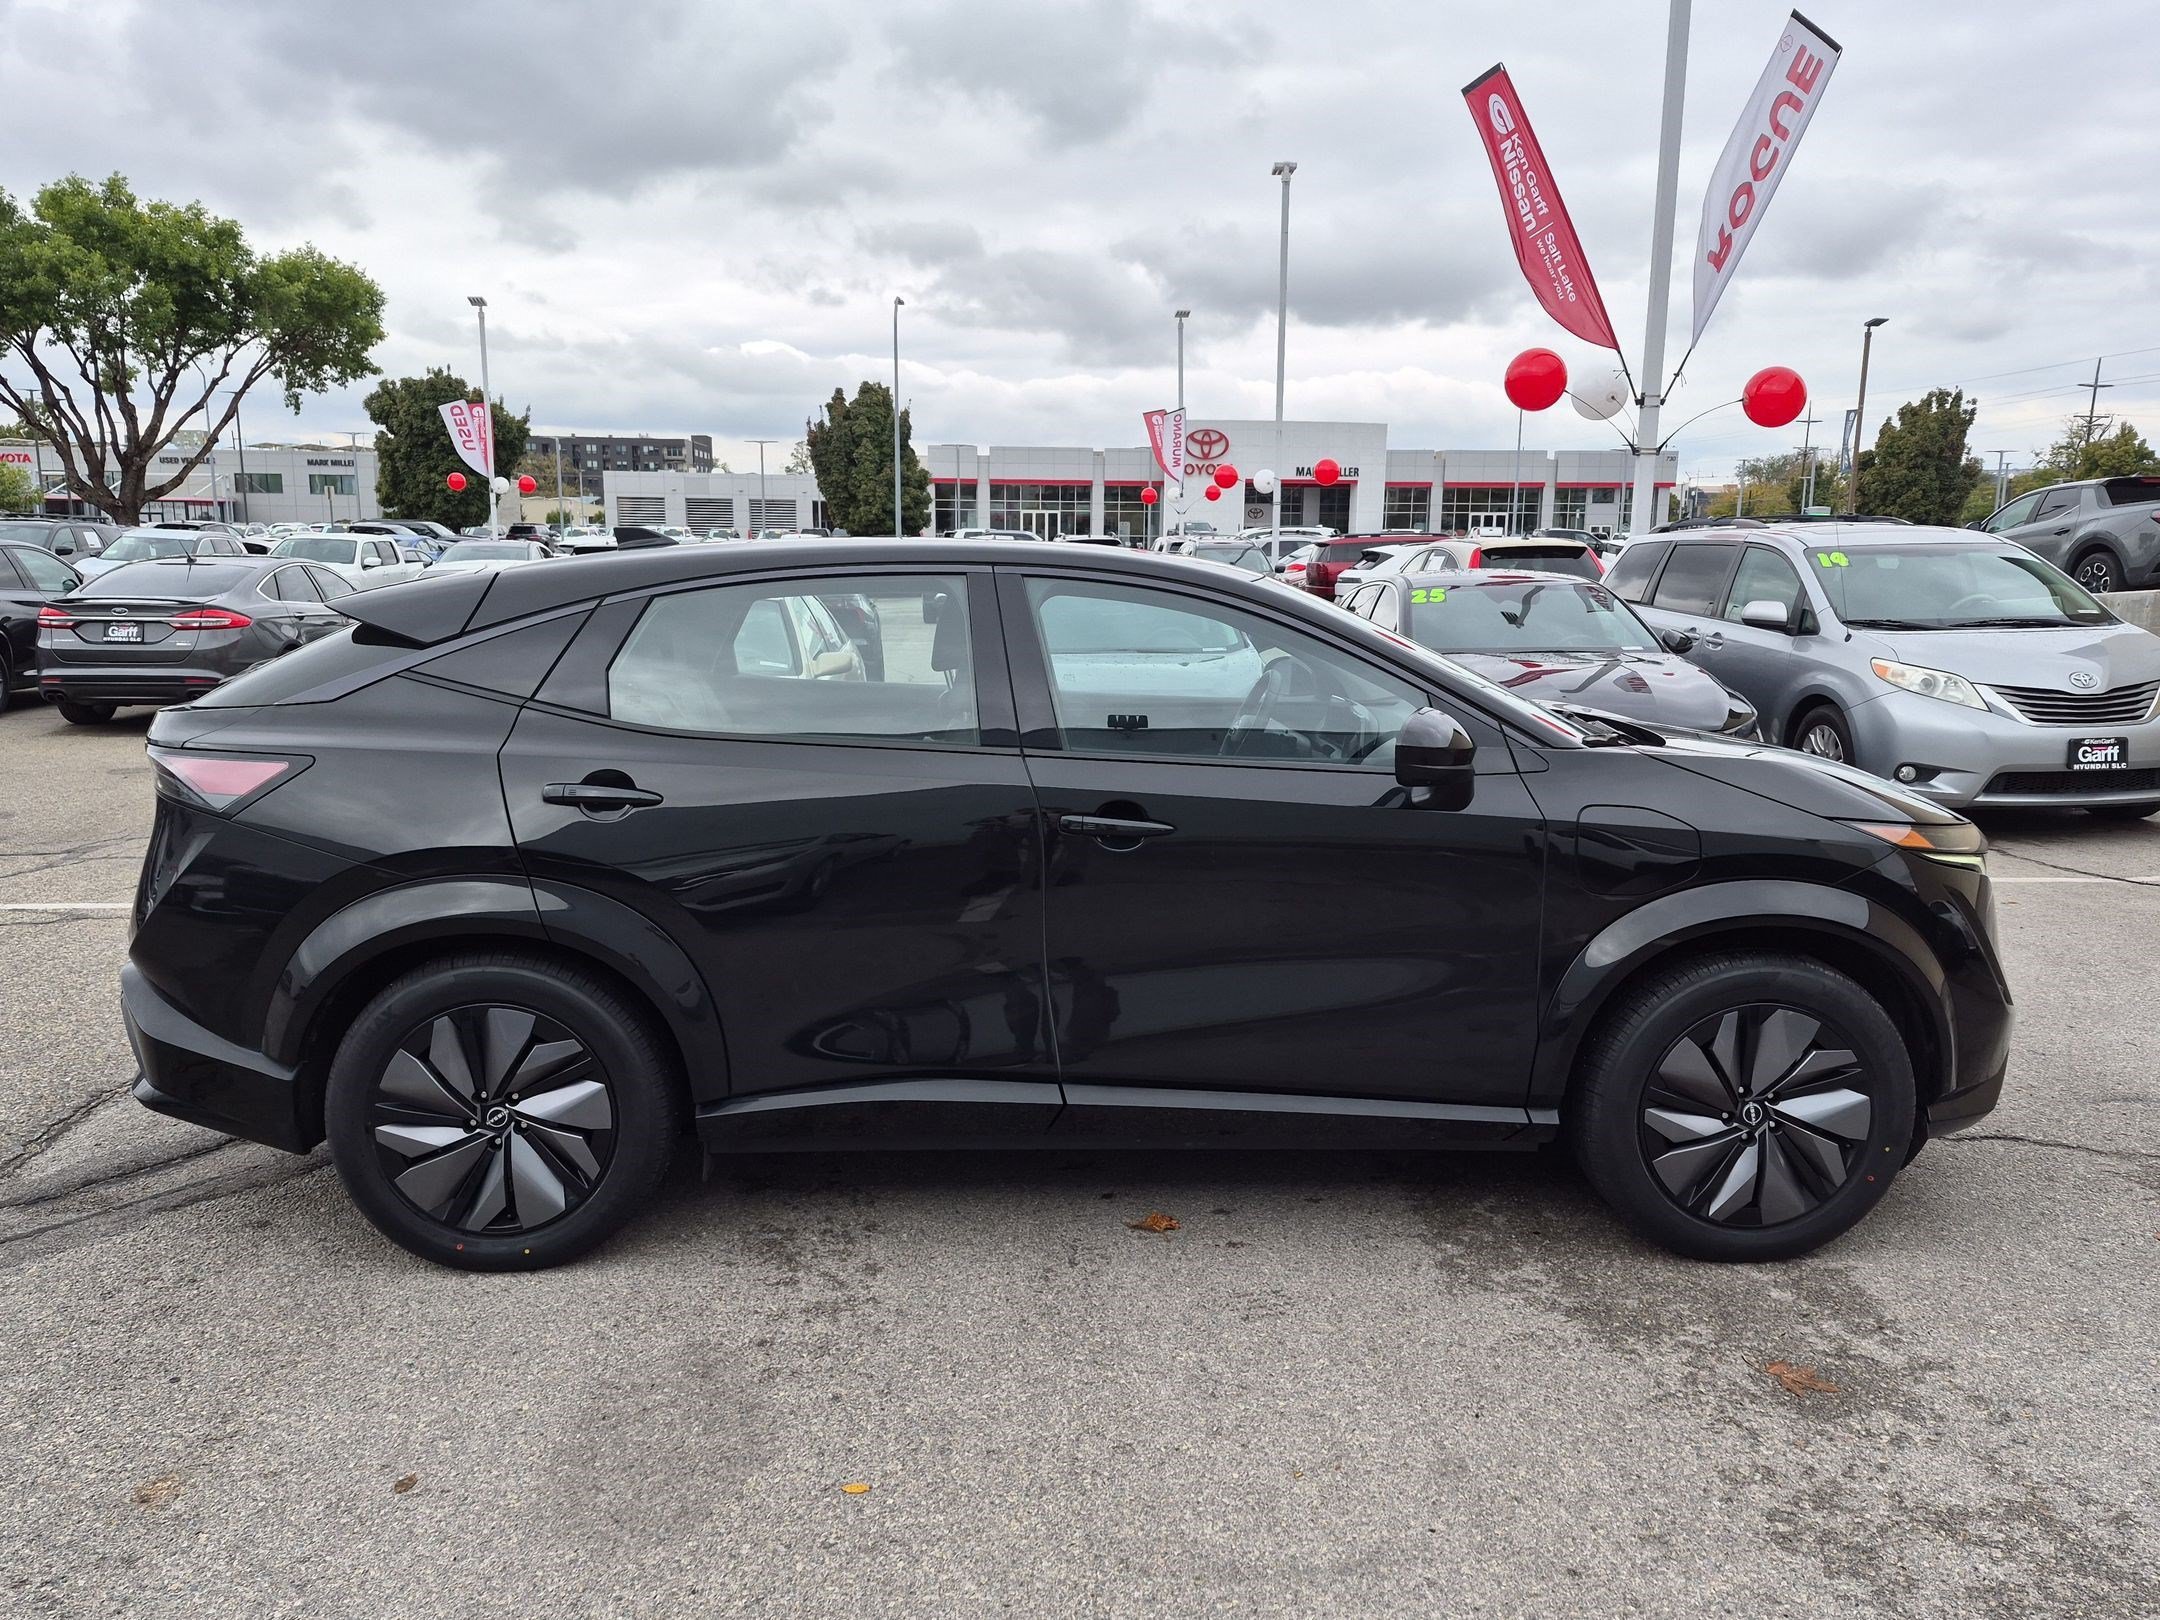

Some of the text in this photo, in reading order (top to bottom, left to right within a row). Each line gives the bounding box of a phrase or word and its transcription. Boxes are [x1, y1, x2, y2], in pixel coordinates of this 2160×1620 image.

[1500, 138, 1537, 233] Nissan
[1536, 238, 1565, 300] we hear you
[1545, 232, 1576, 302] Salt Lake
[158, 456, 179, 464] USED
[307, 458, 329, 466] MARK
[1411, 588, 1447, 604] 25
[108, 626, 138, 637] Garff
[2078, 745, 2120, 762] Garff
